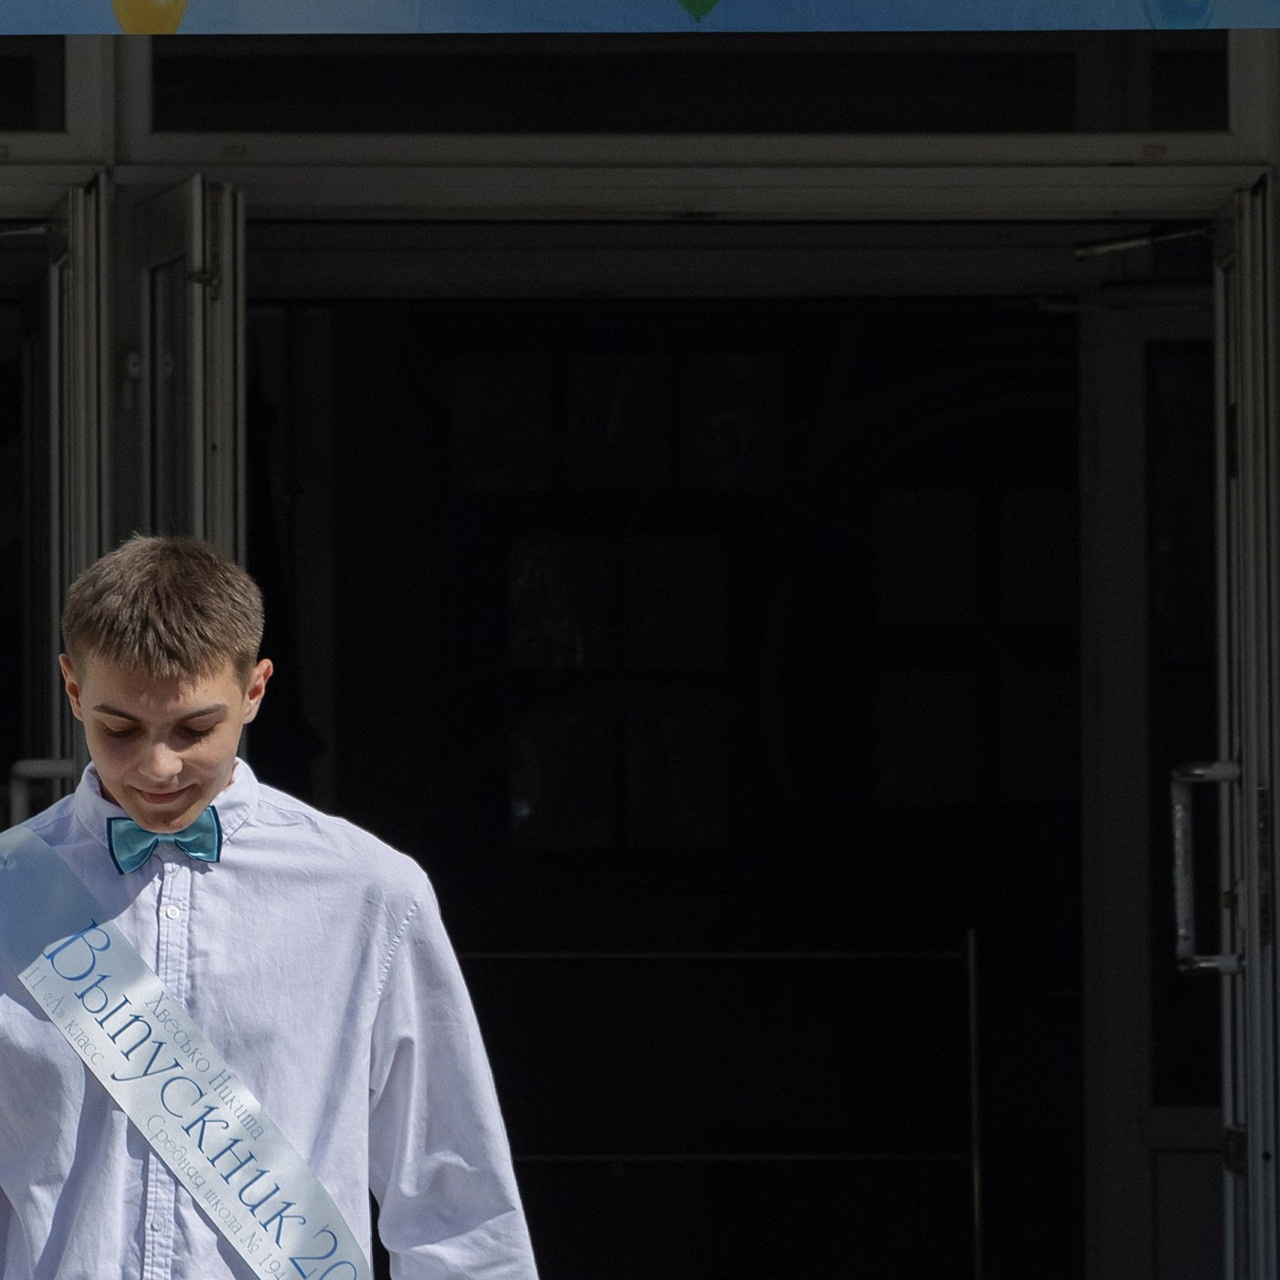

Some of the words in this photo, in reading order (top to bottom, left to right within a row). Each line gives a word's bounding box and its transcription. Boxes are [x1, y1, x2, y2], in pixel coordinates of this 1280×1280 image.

[22, 966, 48, 992] 11
[63, 1019, 105, 1067] класс
[41, 917, 307, 1250] Выпускник
[144, 990, 211, 1073] Хвесько
[207, 1068, 265, 1142] Никита
[144, 1113, 206, 1192] Средняя
[202, 1185, 243, 1237] школа
